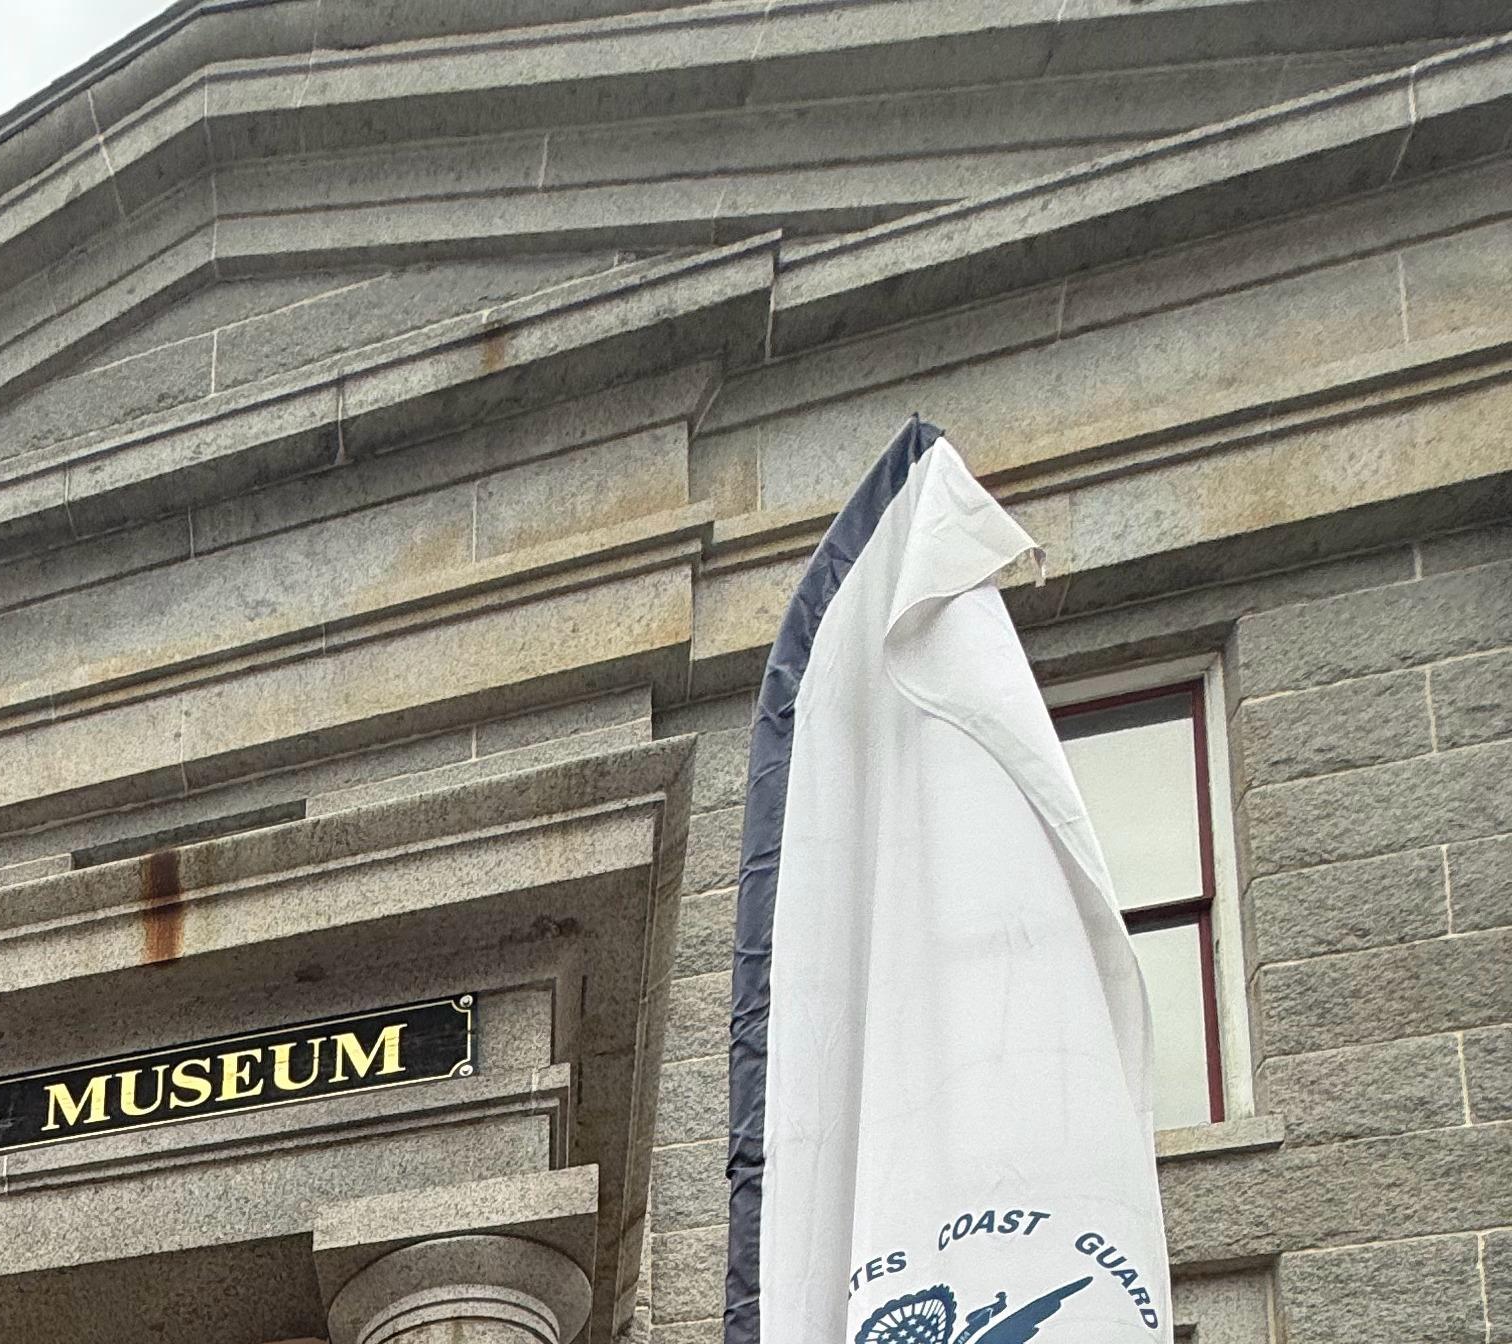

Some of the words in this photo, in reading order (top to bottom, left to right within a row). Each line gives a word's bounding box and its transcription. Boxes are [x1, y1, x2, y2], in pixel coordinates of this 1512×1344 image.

[40, 1023, 407, 1132] MUSEUM
[848, 1251, 907, 1300] TES
[937, 1209, 1050, 1252] COAST
[1074, 1231, 1159, 1331] GUARD
